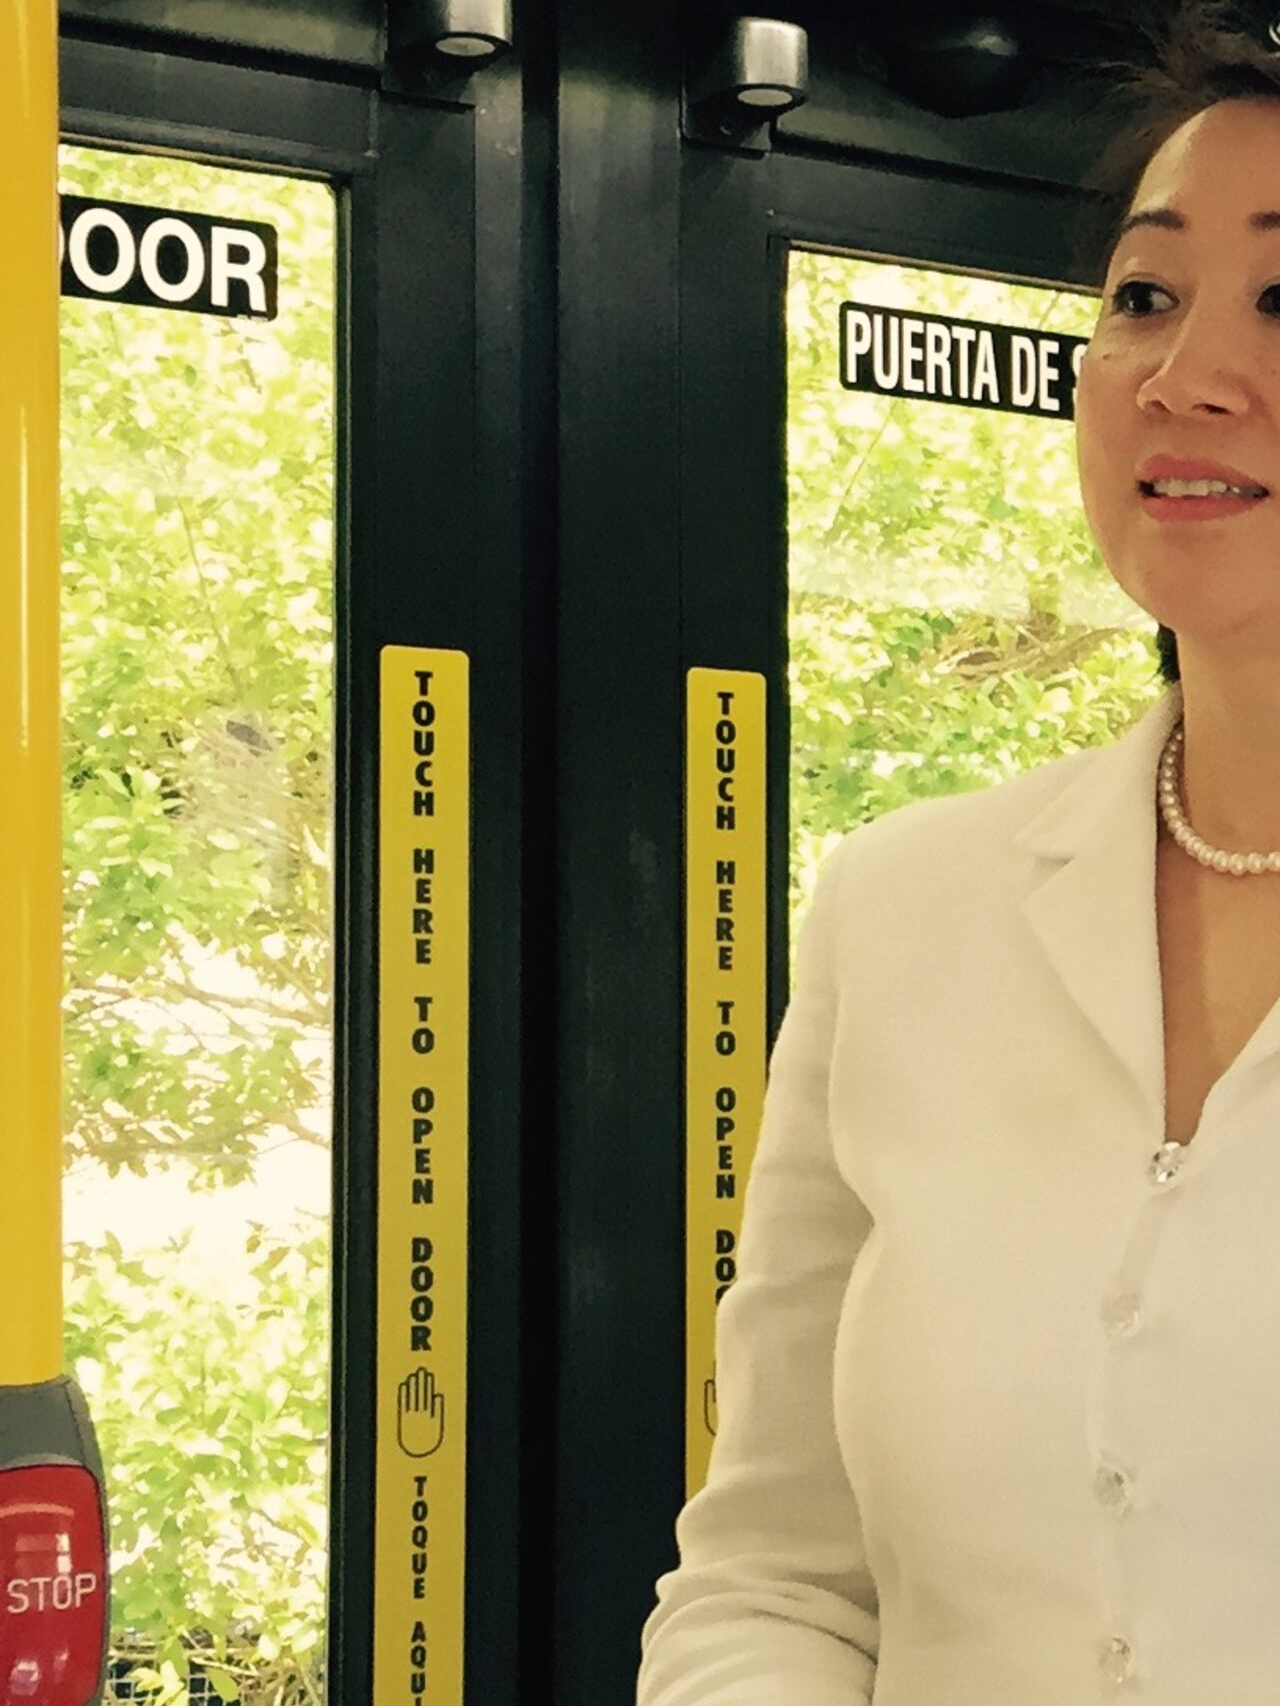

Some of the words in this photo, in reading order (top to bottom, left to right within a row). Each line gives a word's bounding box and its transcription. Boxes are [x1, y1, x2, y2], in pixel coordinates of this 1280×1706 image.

[59, 207, 267, 313] OOR
[846, 309, 1000, 404] PUERTA
[1011, 334, 1060, 412] DE
[412, 671, 436, 817] TOUCH
[715, 692, 736, 831] TOUCH
[412, 848, 435, 965] HERE
[715, 860, 735, 971] HERE
[412, 996, 435, 1055] TO
[715, 1001, 736, 1056] TO
[411, 1087, 435, 1205] OPEN
[715, 1087, 736, 1198] OPEN
[410, 1237, 434, 1352] DOOR
[412, 1475, 428, 1600] TOQUE
[6, 1572, 98, 1615] STOP
